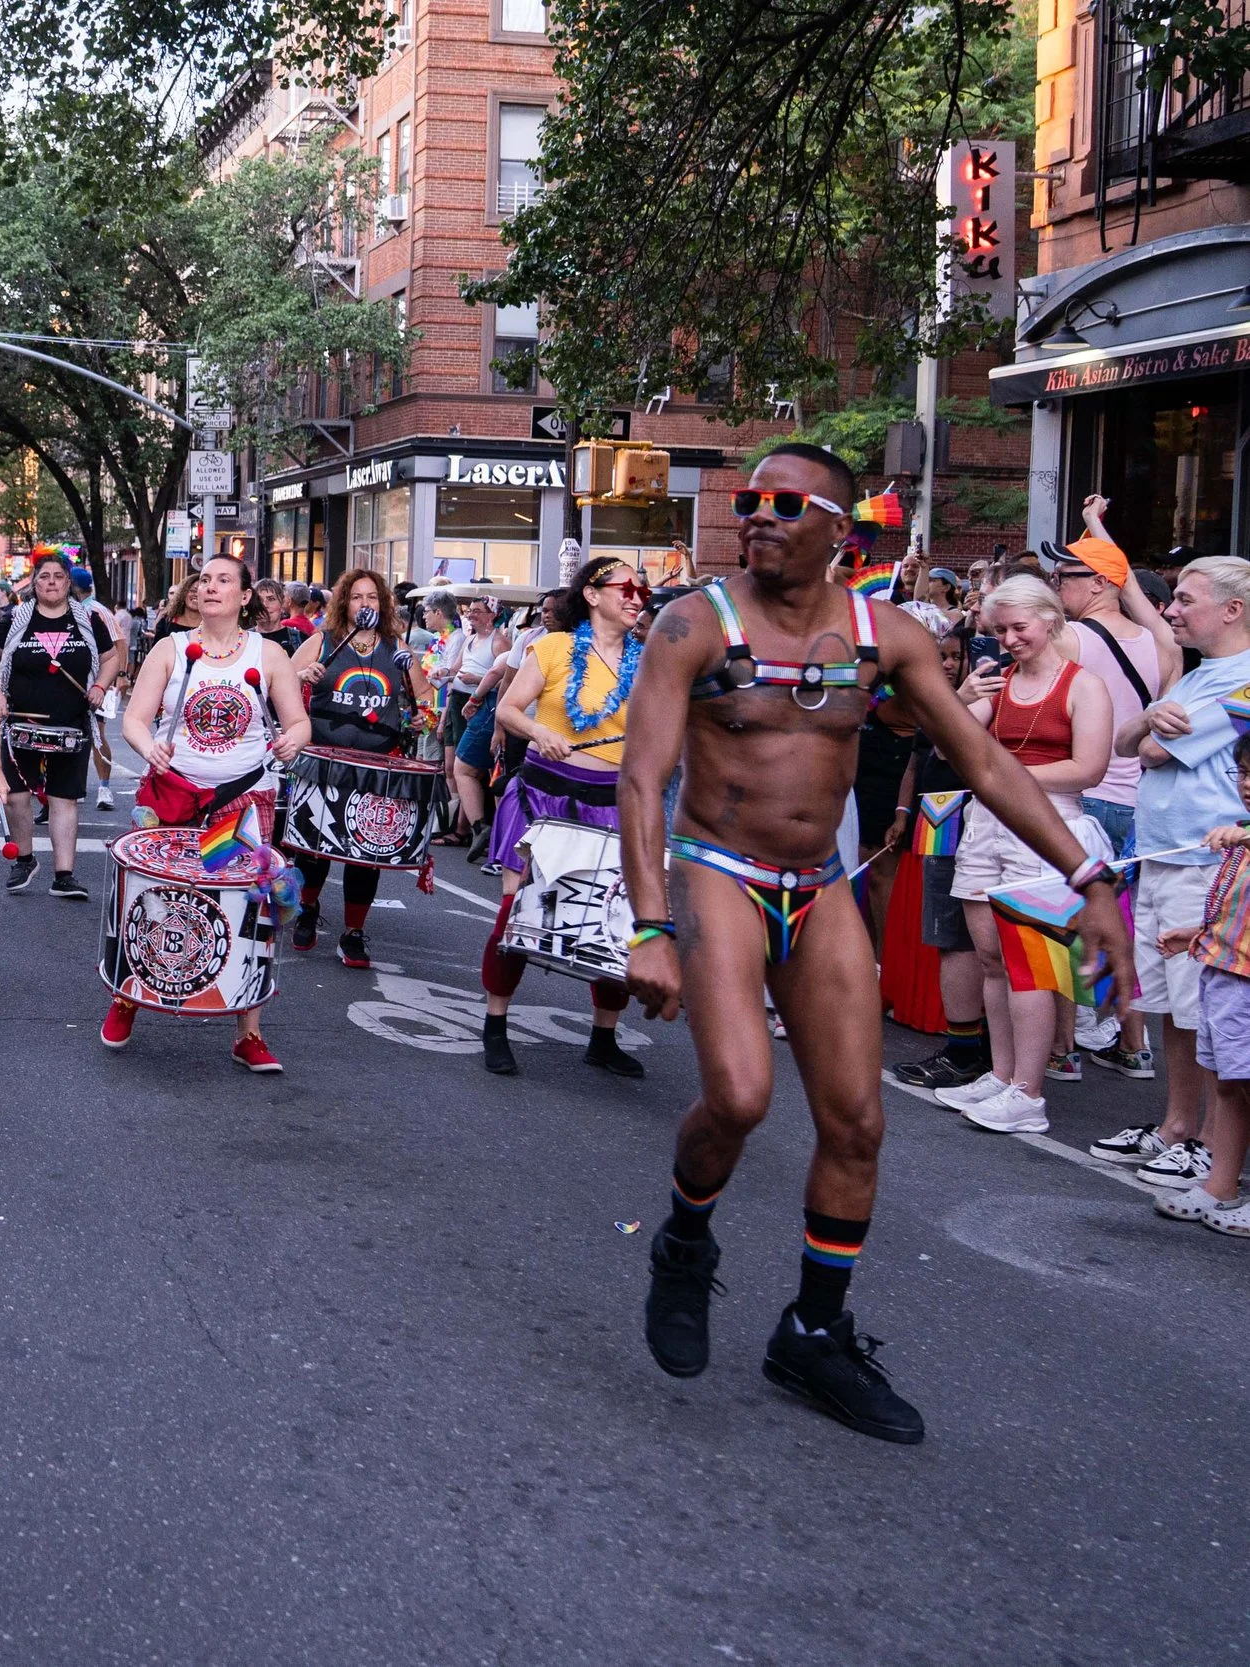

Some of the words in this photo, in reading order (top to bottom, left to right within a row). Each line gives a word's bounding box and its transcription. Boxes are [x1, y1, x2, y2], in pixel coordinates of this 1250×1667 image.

[1045, 371, 1077, 391] Kiku
[1080, 363, 1119, 386] Asian
[1122, 357, 1169, 379] Bistro
[1172, 350, 1187, 371] &
[1190, 344, 1230, 368] Sake
[346, 460, 393, 490] LaserAway
[447, 455, 566, 488] LaserA
[199, 679, 242, 691] BATALA
[332, 690, 354, 706] BE
[359, 694, 391, 709] YOU
[186, 736, 207, 753] NEW
[210, 740, 238, 755] YORK
[361, 840, 395, 854] MUNDO
[159, 891, 209, 914] ATALA
[146, 975, 193, 992] MUNDO
